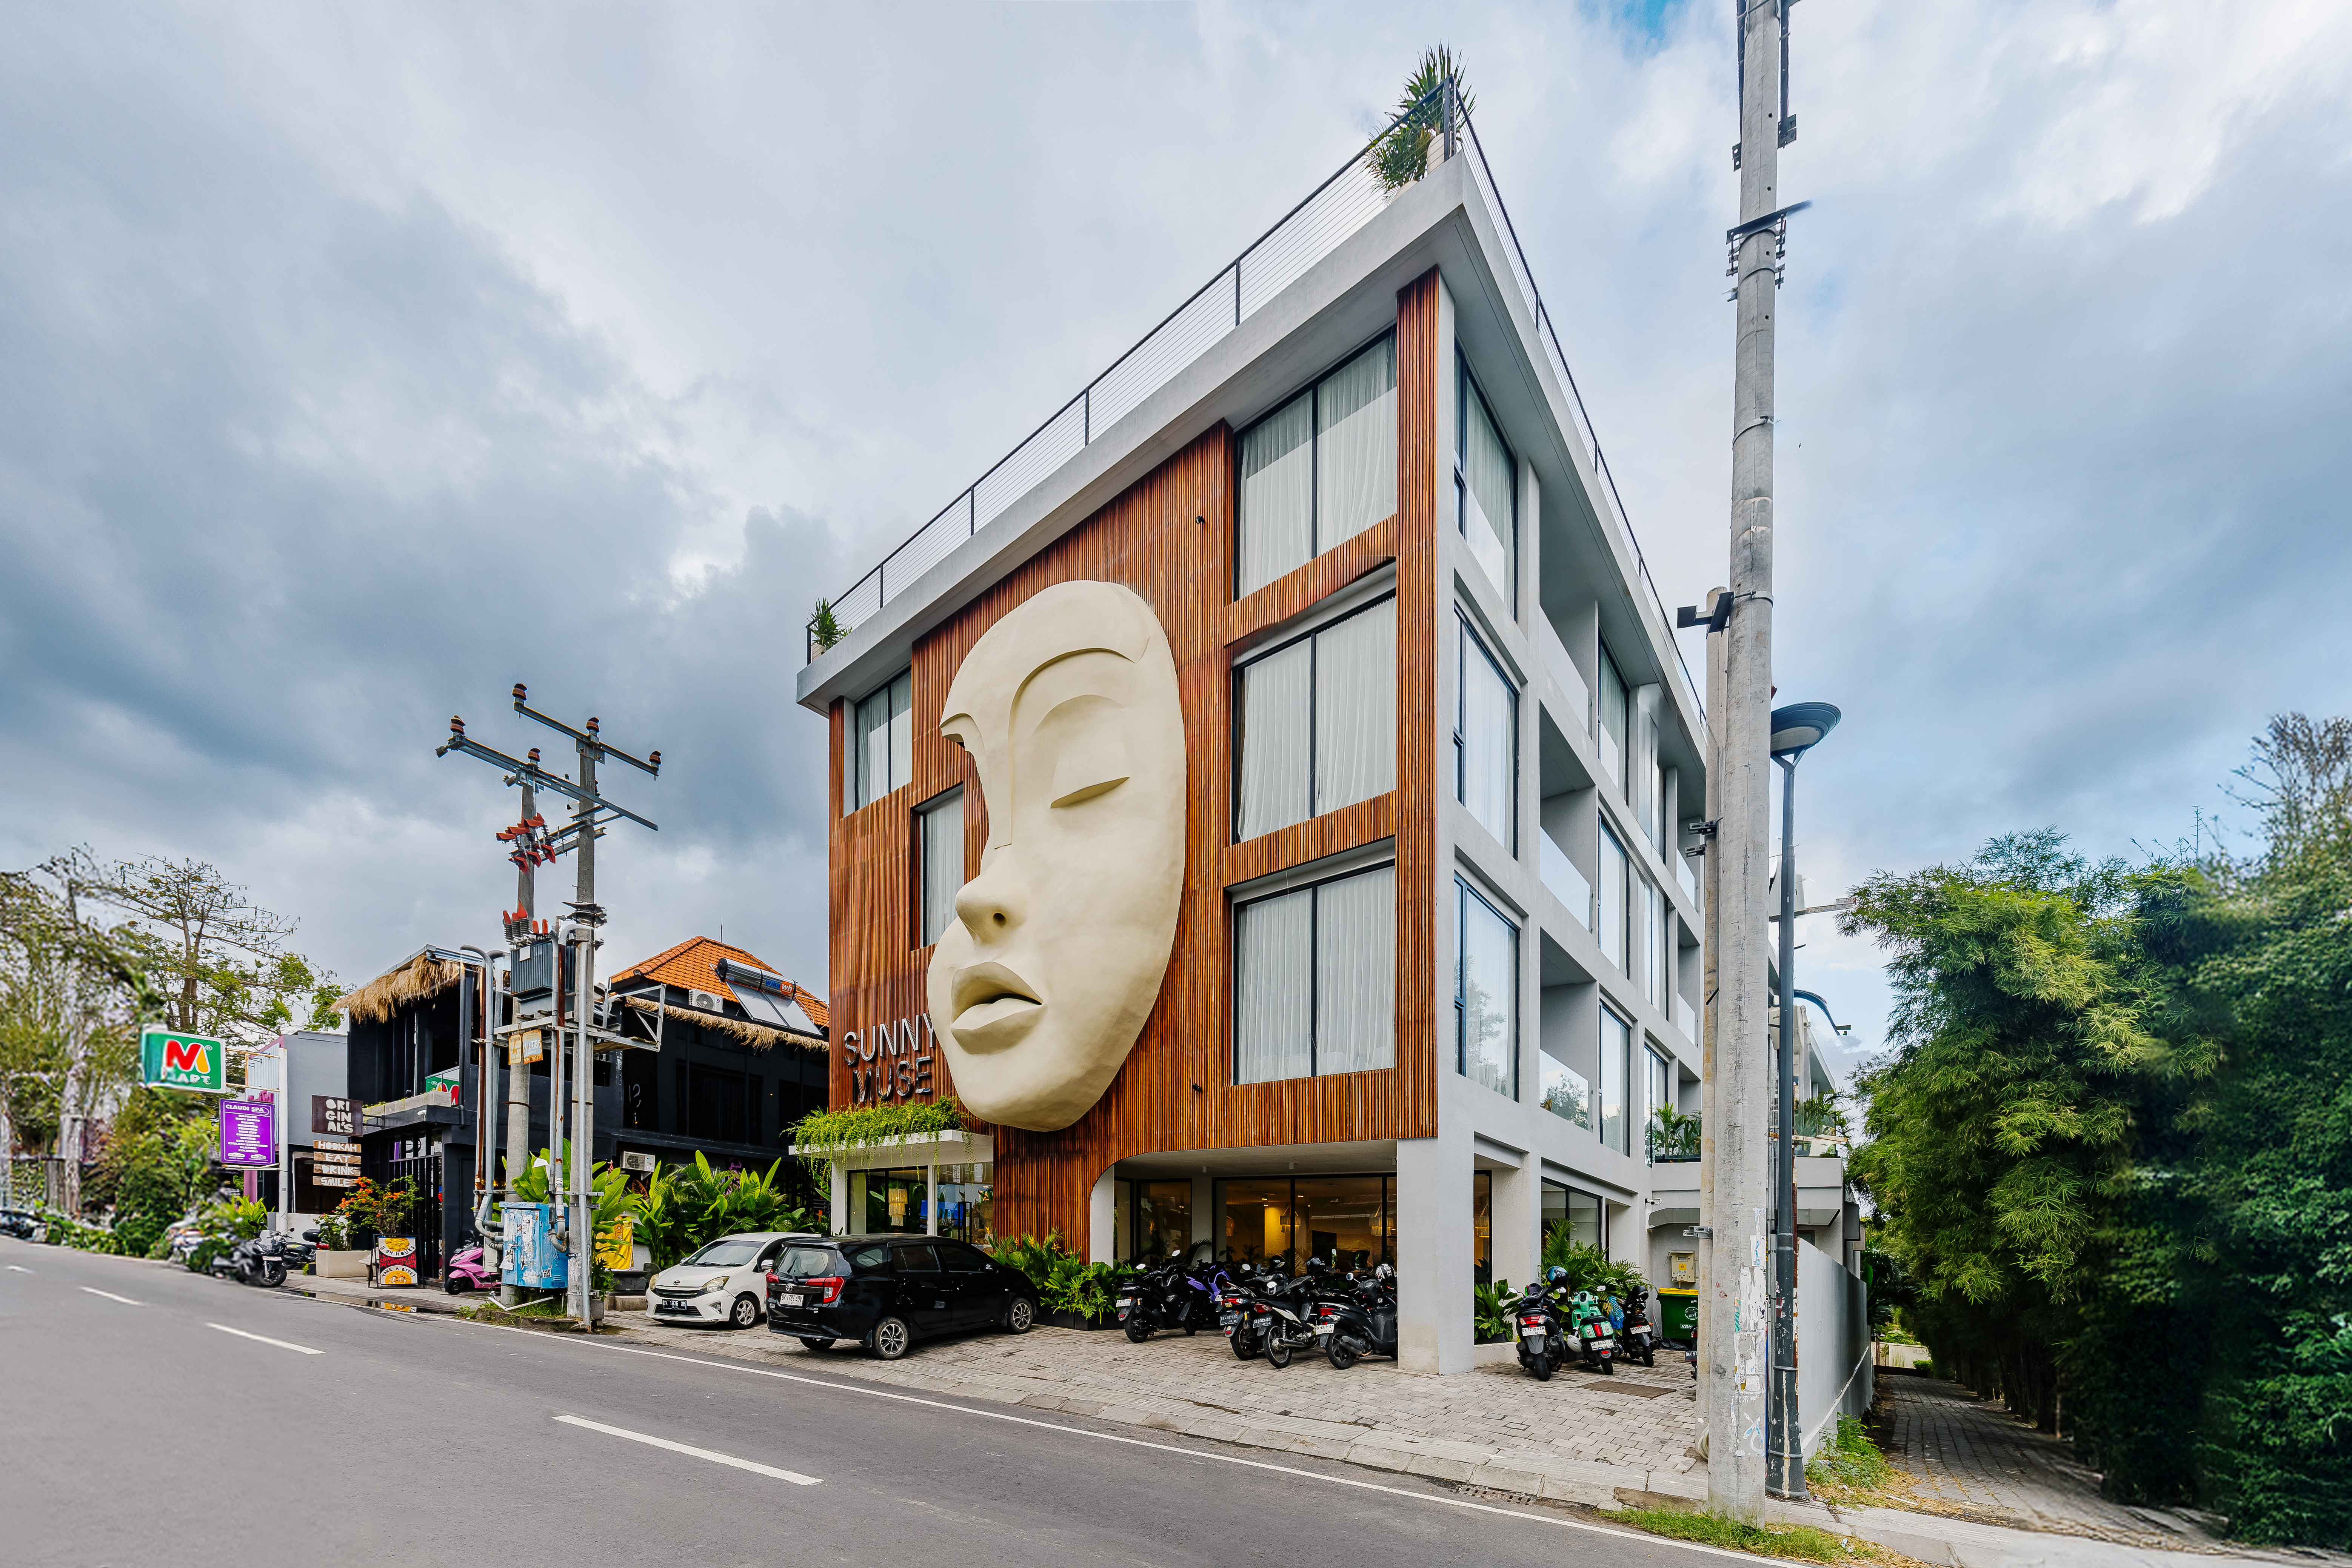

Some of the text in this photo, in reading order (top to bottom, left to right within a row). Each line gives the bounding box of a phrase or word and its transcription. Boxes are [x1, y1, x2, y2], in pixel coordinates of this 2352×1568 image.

[844, 1013, 934, 1065] SUNNY
[166, 1073, 212, 1085] ART
[853, 1056, 933, 1103] MUSE
[326, 1099, 350, 1111] ORI
[325, 1110, 351, 1122] GIN
[328, 1121, 354, 1133] AL'S
[318, 1141, 357, 1152] HOOKAH
[325, 1153, 351, 1163] EAT
[321, 1165, 354, 1175] DRINK
[320, 1177, 351, 1187] SMILE
[396, 1246, 415, 1256] HOURS
[382, 1268, 393, 1277] TAKE
[402, 1267, 416, 1277] BITE!
